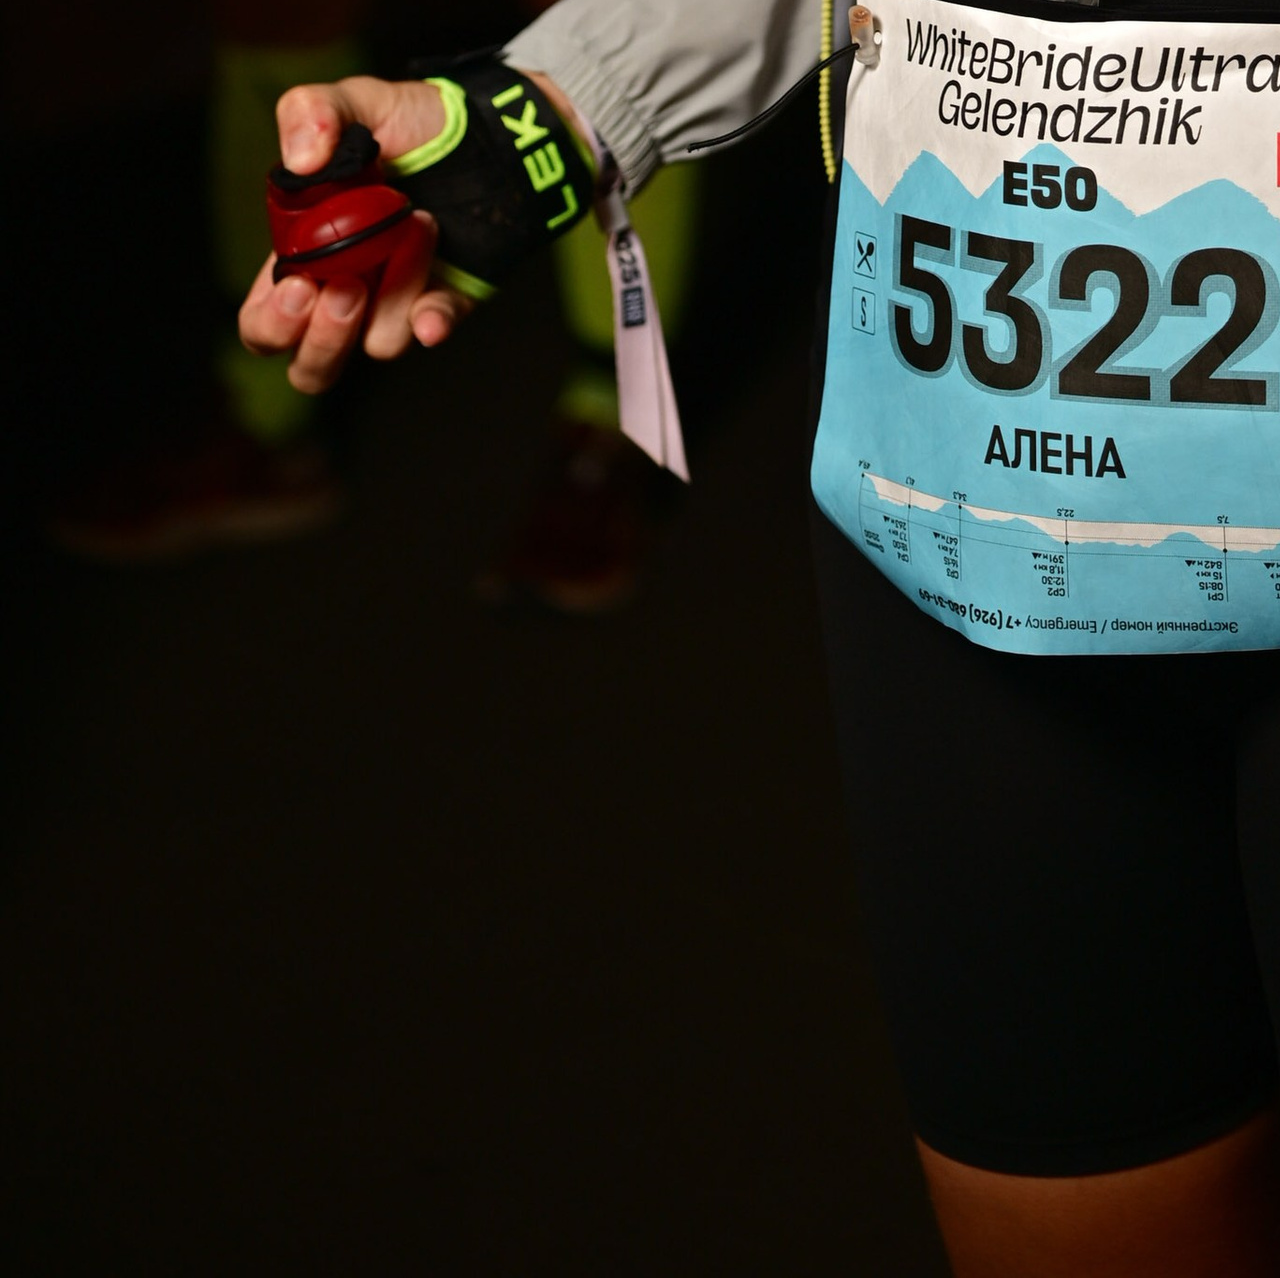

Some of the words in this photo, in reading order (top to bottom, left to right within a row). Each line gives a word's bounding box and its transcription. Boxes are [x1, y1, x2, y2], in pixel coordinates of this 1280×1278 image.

[937, 79, 1204, 146] Gelendzhik
[491, 83, 580, 231] LEKI
[1001, 160, 1098, 212] E50
[892, 213, 1270, 407] 5322
[984, 424, 1127, 479] АЛЕНА
[952, 491, 967, 502] 34,3
[1056, 507, 1075, 518] 22,5
[1217, 515, 1230, 524] 7,5
[945, 536, 959, 546] 647
[1049, 554, 1064, 564] 391
[1204, 561, 1222, 569] 842
[1049, 565, 1064, 574] 11,8
[1213, 571, 1223, 580] 15
[1041, 575, 1065, 586] 12:30
[1199, 582, 1224, 591] 08:15
[969, 603, 1003, 630] (926)
[1005, 615, 1022, 629] +7
[1025, 614, 1097, 634] Emergency
[1111, 618, 1152, 631] номер
[1156, 619, 1239, 634] Экстренный
